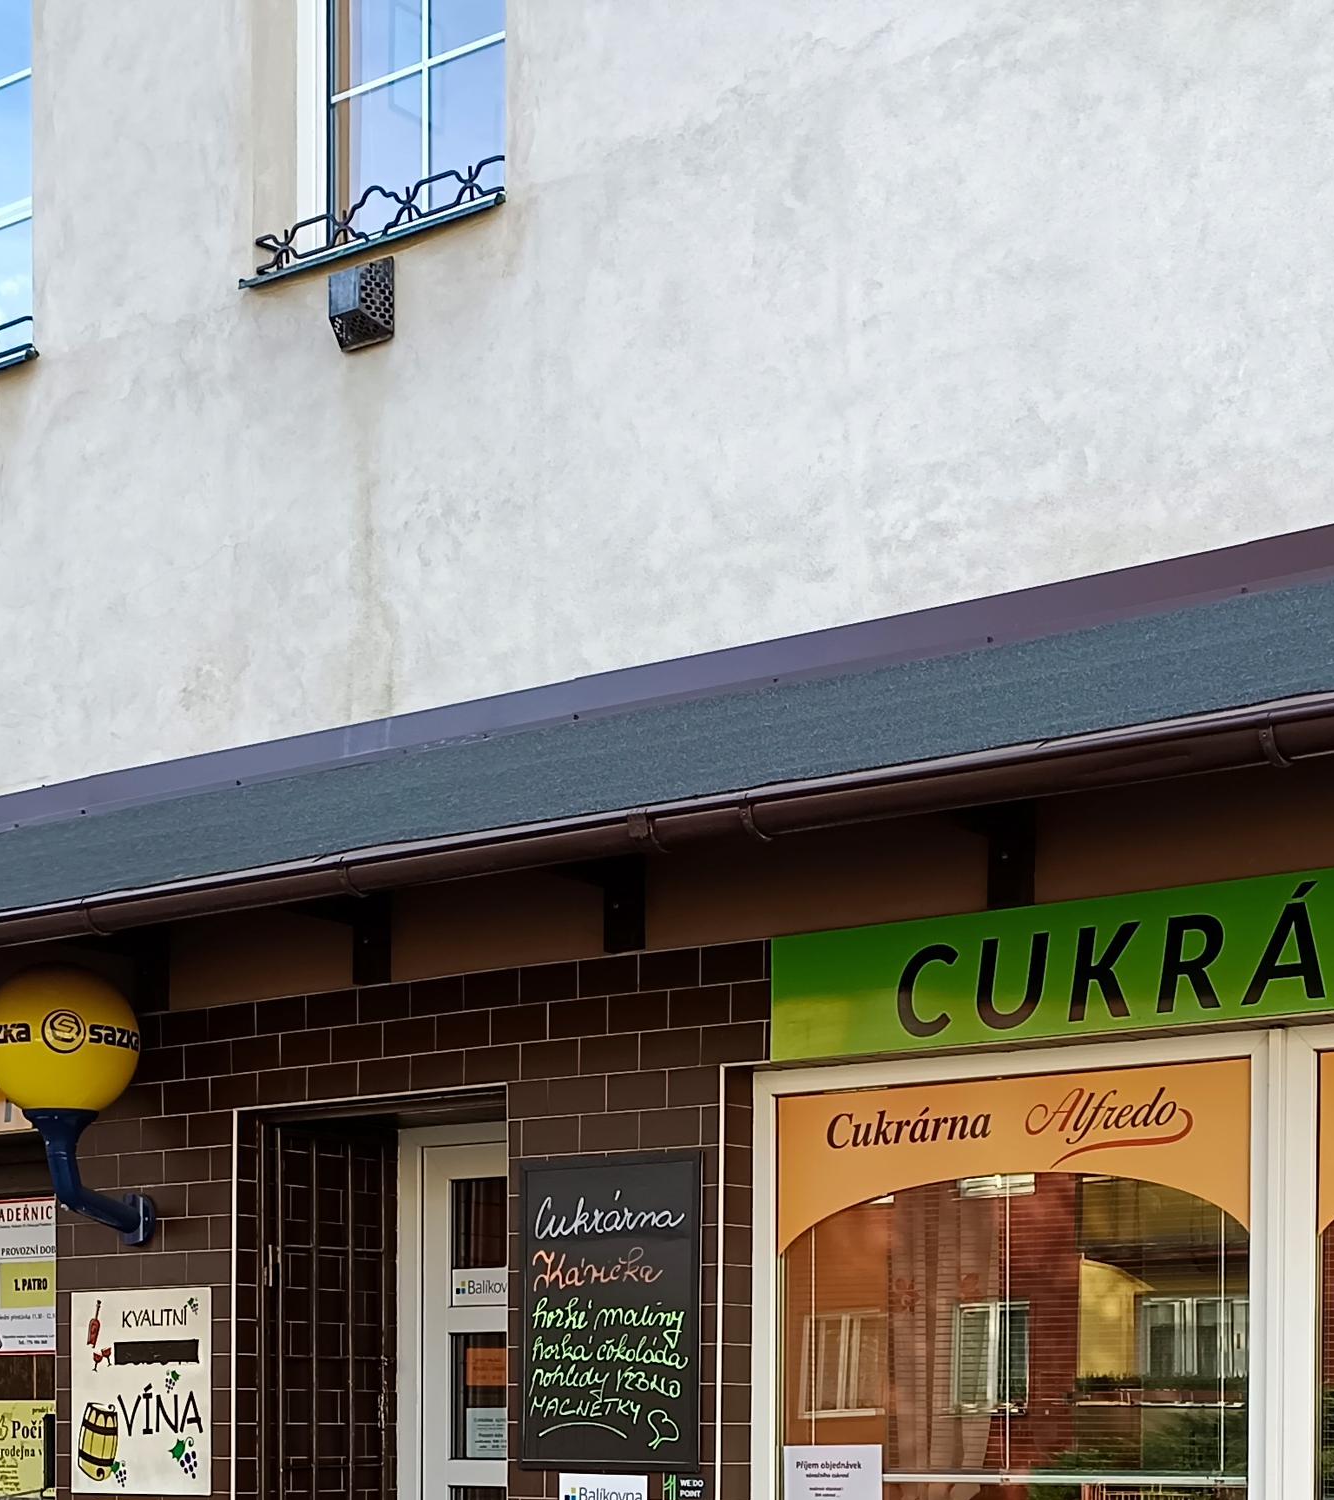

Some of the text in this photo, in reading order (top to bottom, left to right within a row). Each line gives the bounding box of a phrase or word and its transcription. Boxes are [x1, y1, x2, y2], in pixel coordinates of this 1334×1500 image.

[825, 1086, 1195, 1168] Cukrárna Alfredo
[534, 1190, 685, 1239] Cukrárna
[22, 1278, 48, 1291] PATRO
[121, 1304, 189, 1329] KVALITNÍ
[532, 1297, 685, 1349] horké maliny
[532, 1334, 689, 1370] horká čokoláda
[117, 1382, 204, 1437] VÍNA
[796, 1461, 862, 1470] Příjem objednávek
[679, 1489, 702, 1498] POINT
